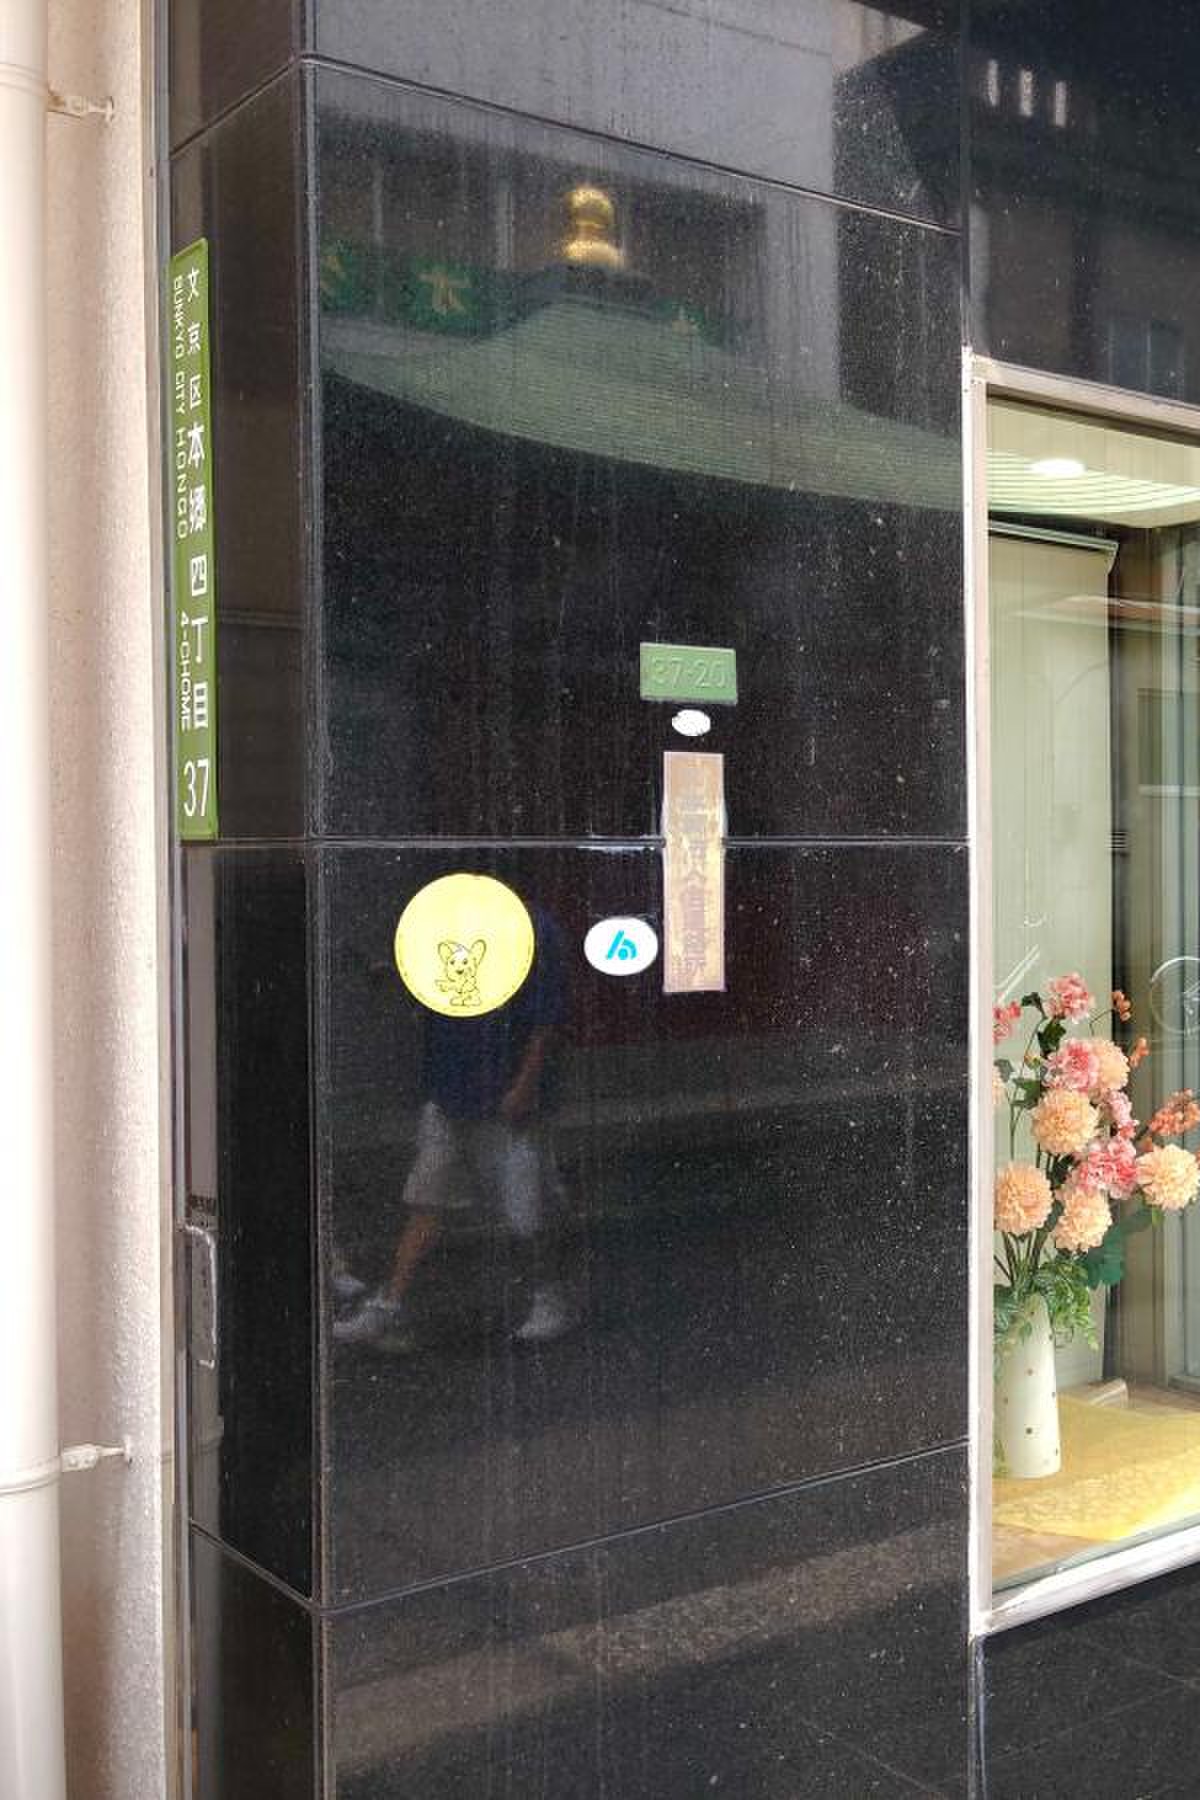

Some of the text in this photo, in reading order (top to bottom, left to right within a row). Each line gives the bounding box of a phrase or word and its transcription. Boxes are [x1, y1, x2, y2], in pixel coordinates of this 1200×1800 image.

[173, 275, 186, 360] BUNKYO
[175, 370, 186, 415] CITY
[176, 428, 189, 539] HONGO
[183, 758, 209, 818] 37
